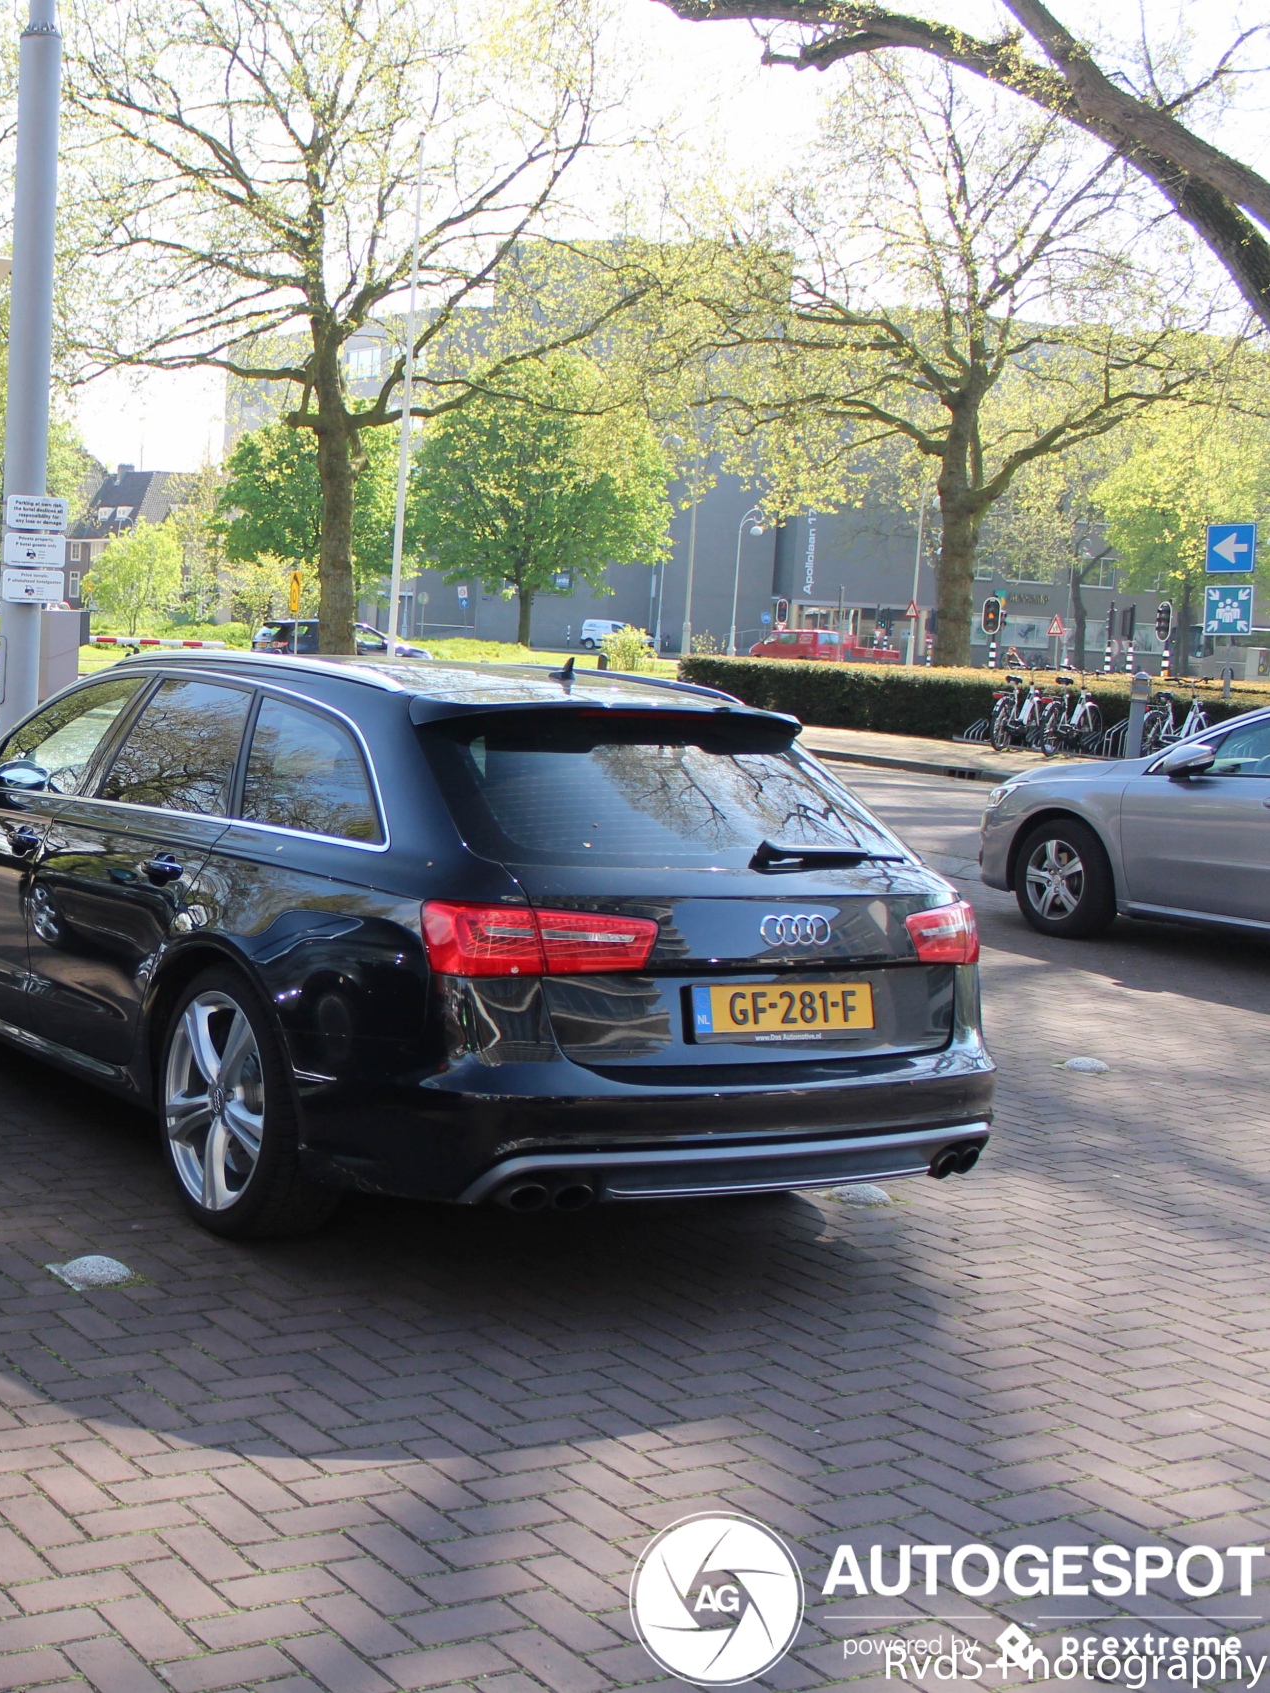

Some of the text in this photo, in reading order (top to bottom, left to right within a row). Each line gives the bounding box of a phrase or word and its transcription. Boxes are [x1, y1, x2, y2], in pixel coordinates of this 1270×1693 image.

[803, 528, 816, 595] Apollolaan
[697, 1015, 711, 1026] NL
[729, 990, 857, 1025] GF-281-F
